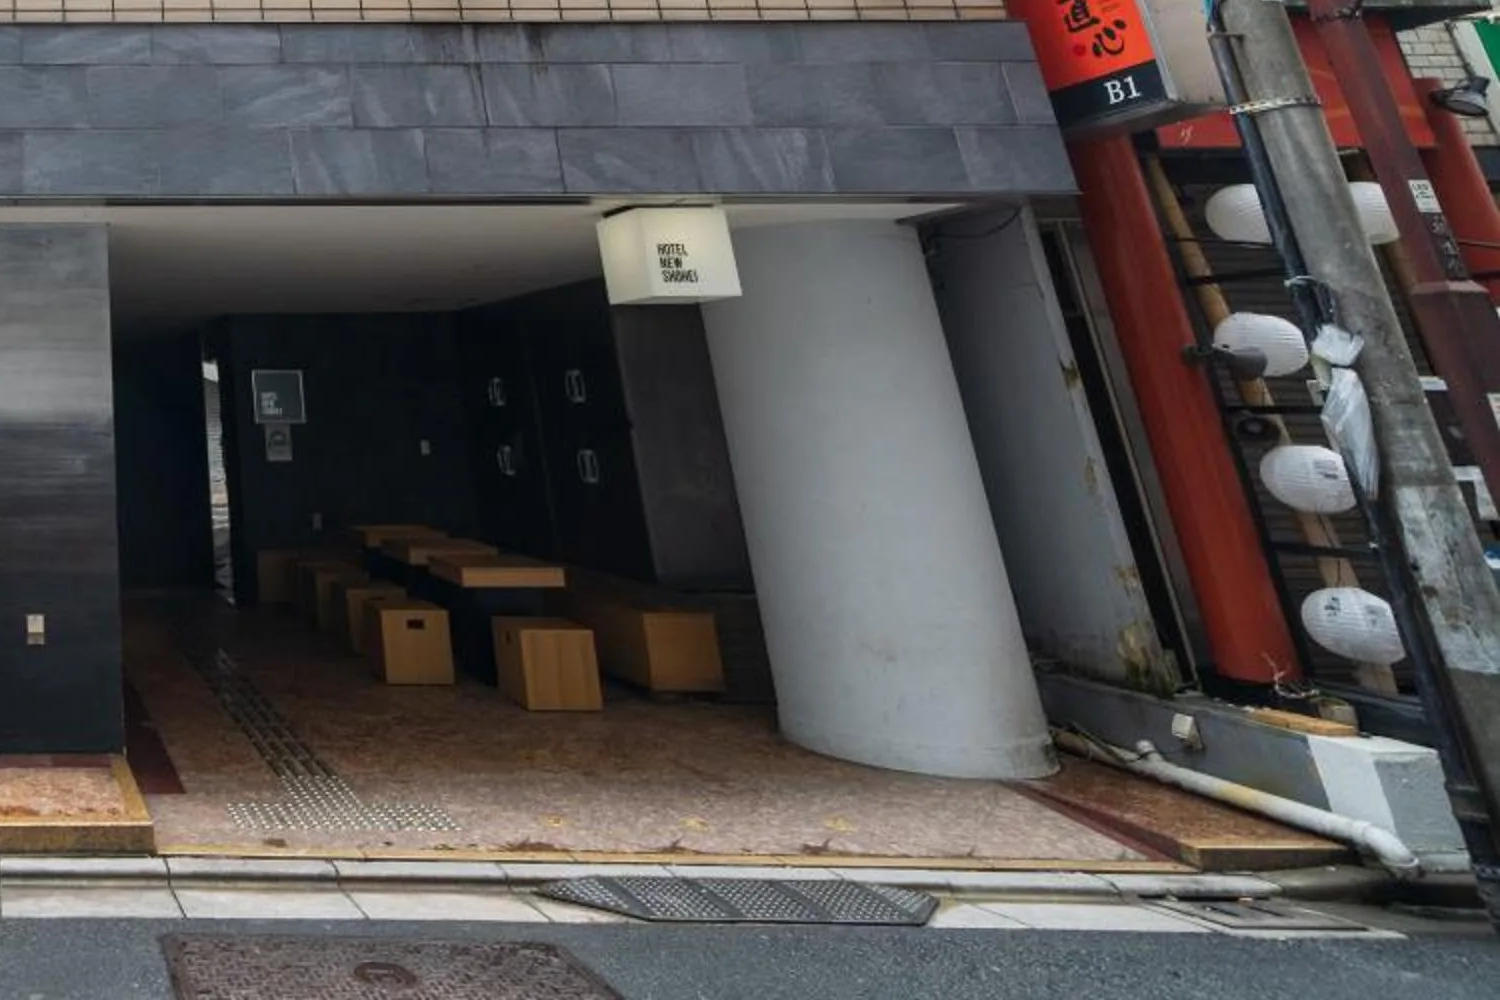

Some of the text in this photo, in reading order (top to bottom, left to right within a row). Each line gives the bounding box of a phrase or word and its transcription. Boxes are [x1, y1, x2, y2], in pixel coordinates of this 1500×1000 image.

[1103, 74, 1143, 106] B1
[657, 242, 690, 257] HOTEL
[659, 257, 682, 269] NEW
[661, 269, 700, 284] SHOHEI
